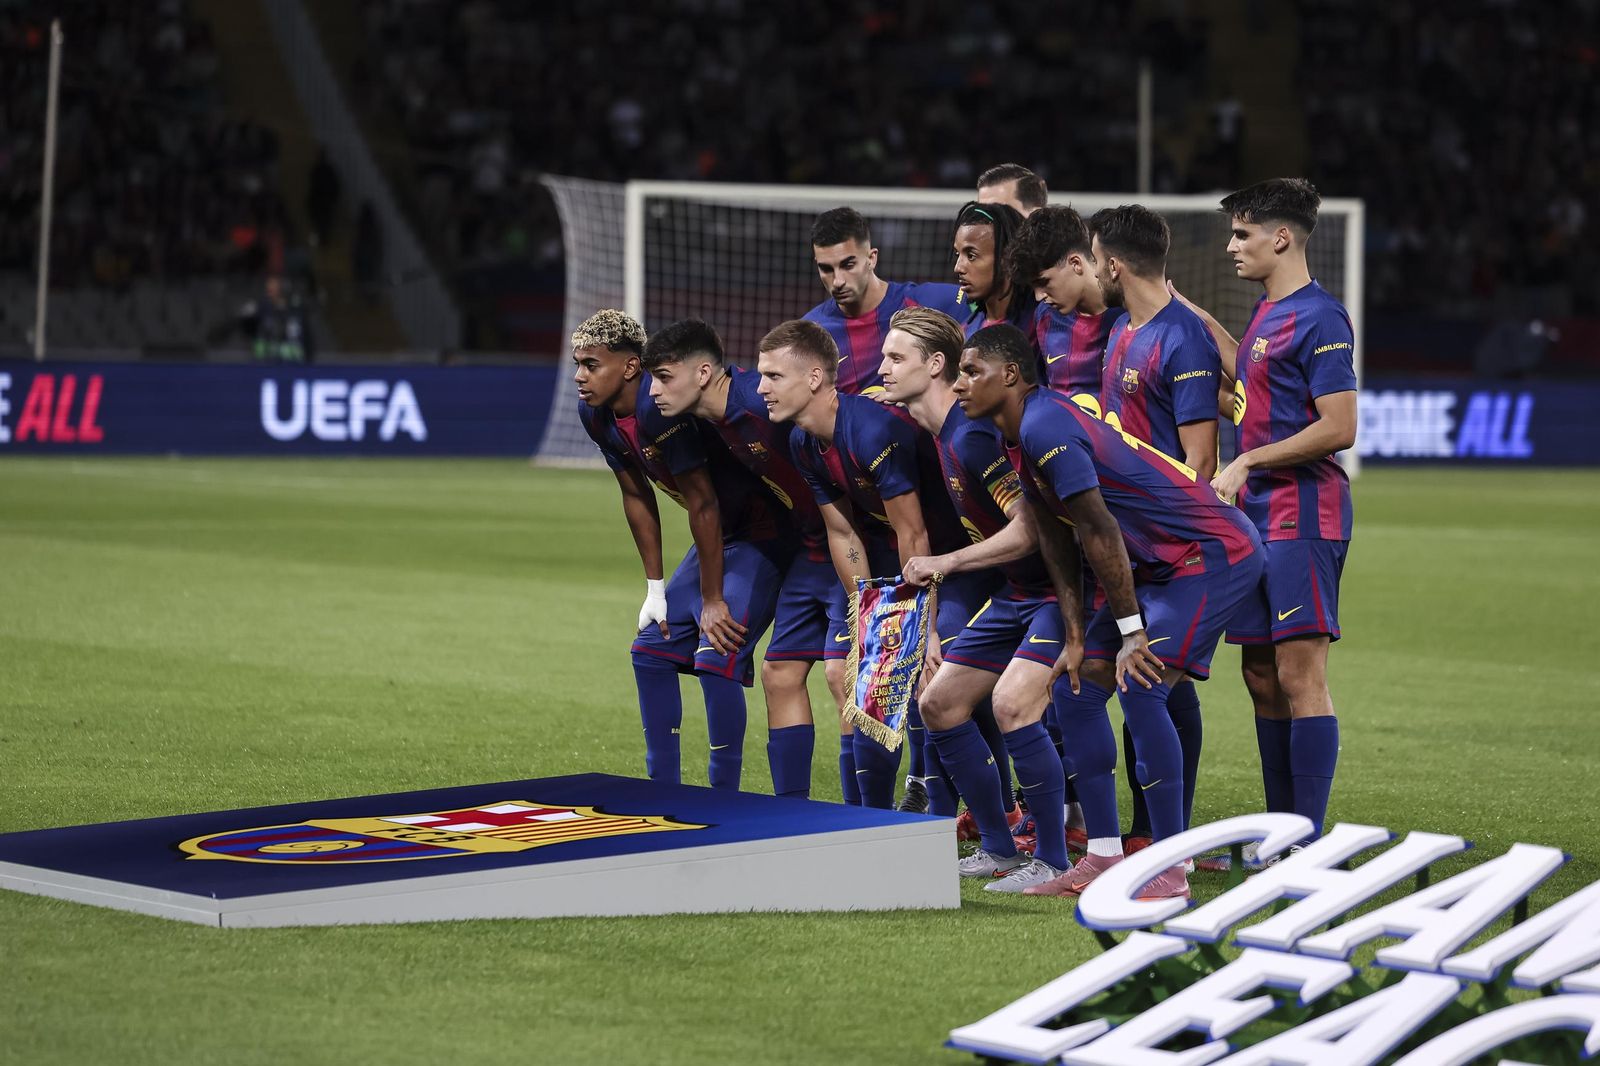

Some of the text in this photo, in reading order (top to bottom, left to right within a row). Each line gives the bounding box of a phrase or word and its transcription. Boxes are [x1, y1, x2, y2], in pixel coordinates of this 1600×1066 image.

[1314, 342, 1347, 355] AMBILIGHT
[1174, 370, 1206, 382] AMBILIGHT
[15, 373, 104, 443] ALL
[260, 379, 428, 441] UEFA
[1455, 391, 1534, 458] ALL
[871, 684, 896, 698] LEAGUE
[363, 826, 477, 843] FCB
